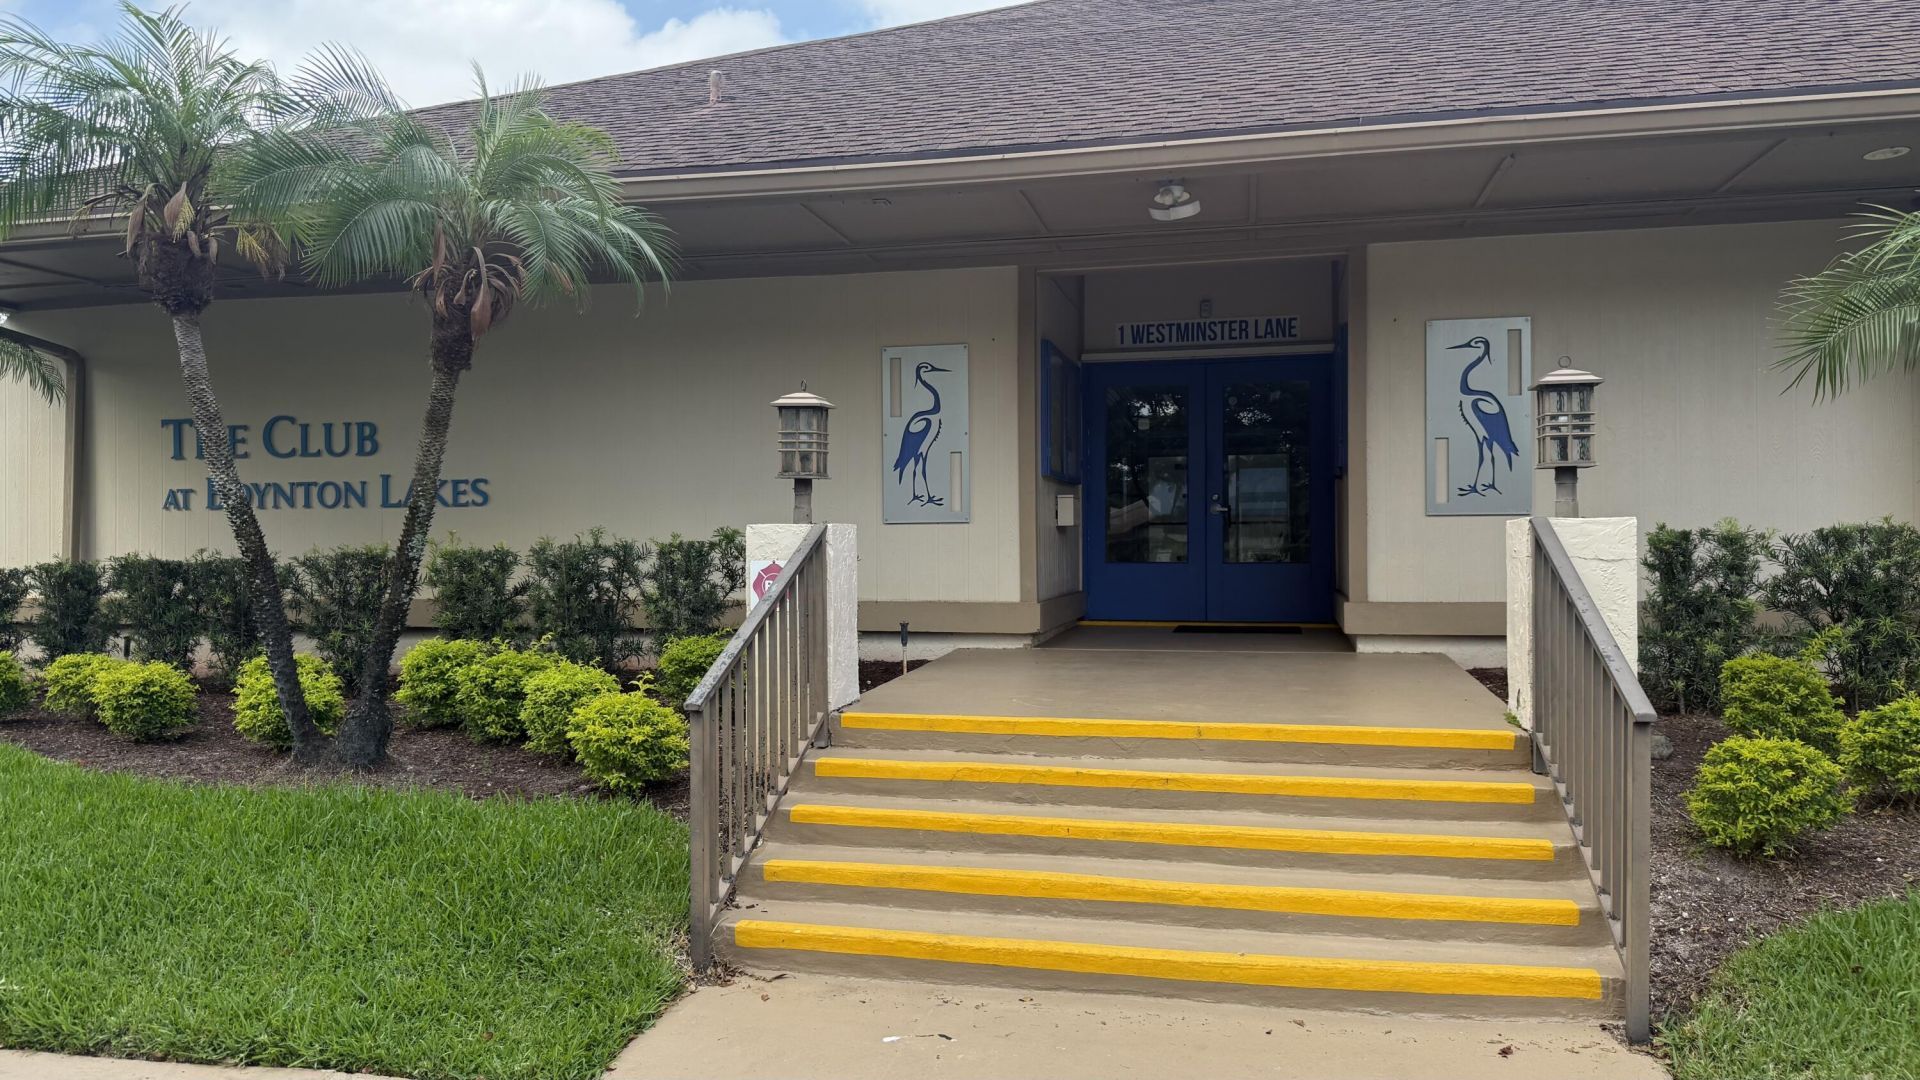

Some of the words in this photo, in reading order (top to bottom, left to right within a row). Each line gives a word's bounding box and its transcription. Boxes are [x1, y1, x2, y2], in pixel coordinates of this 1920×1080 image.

[1118, 326, 1125, 344] 1
[1130, 319, 1249, 344] WESTMINSTER
[1255, 317, 1297, 338] LANE
[262, 415, 379, 458] CLUB
[162, 488, 194, 511] AT
